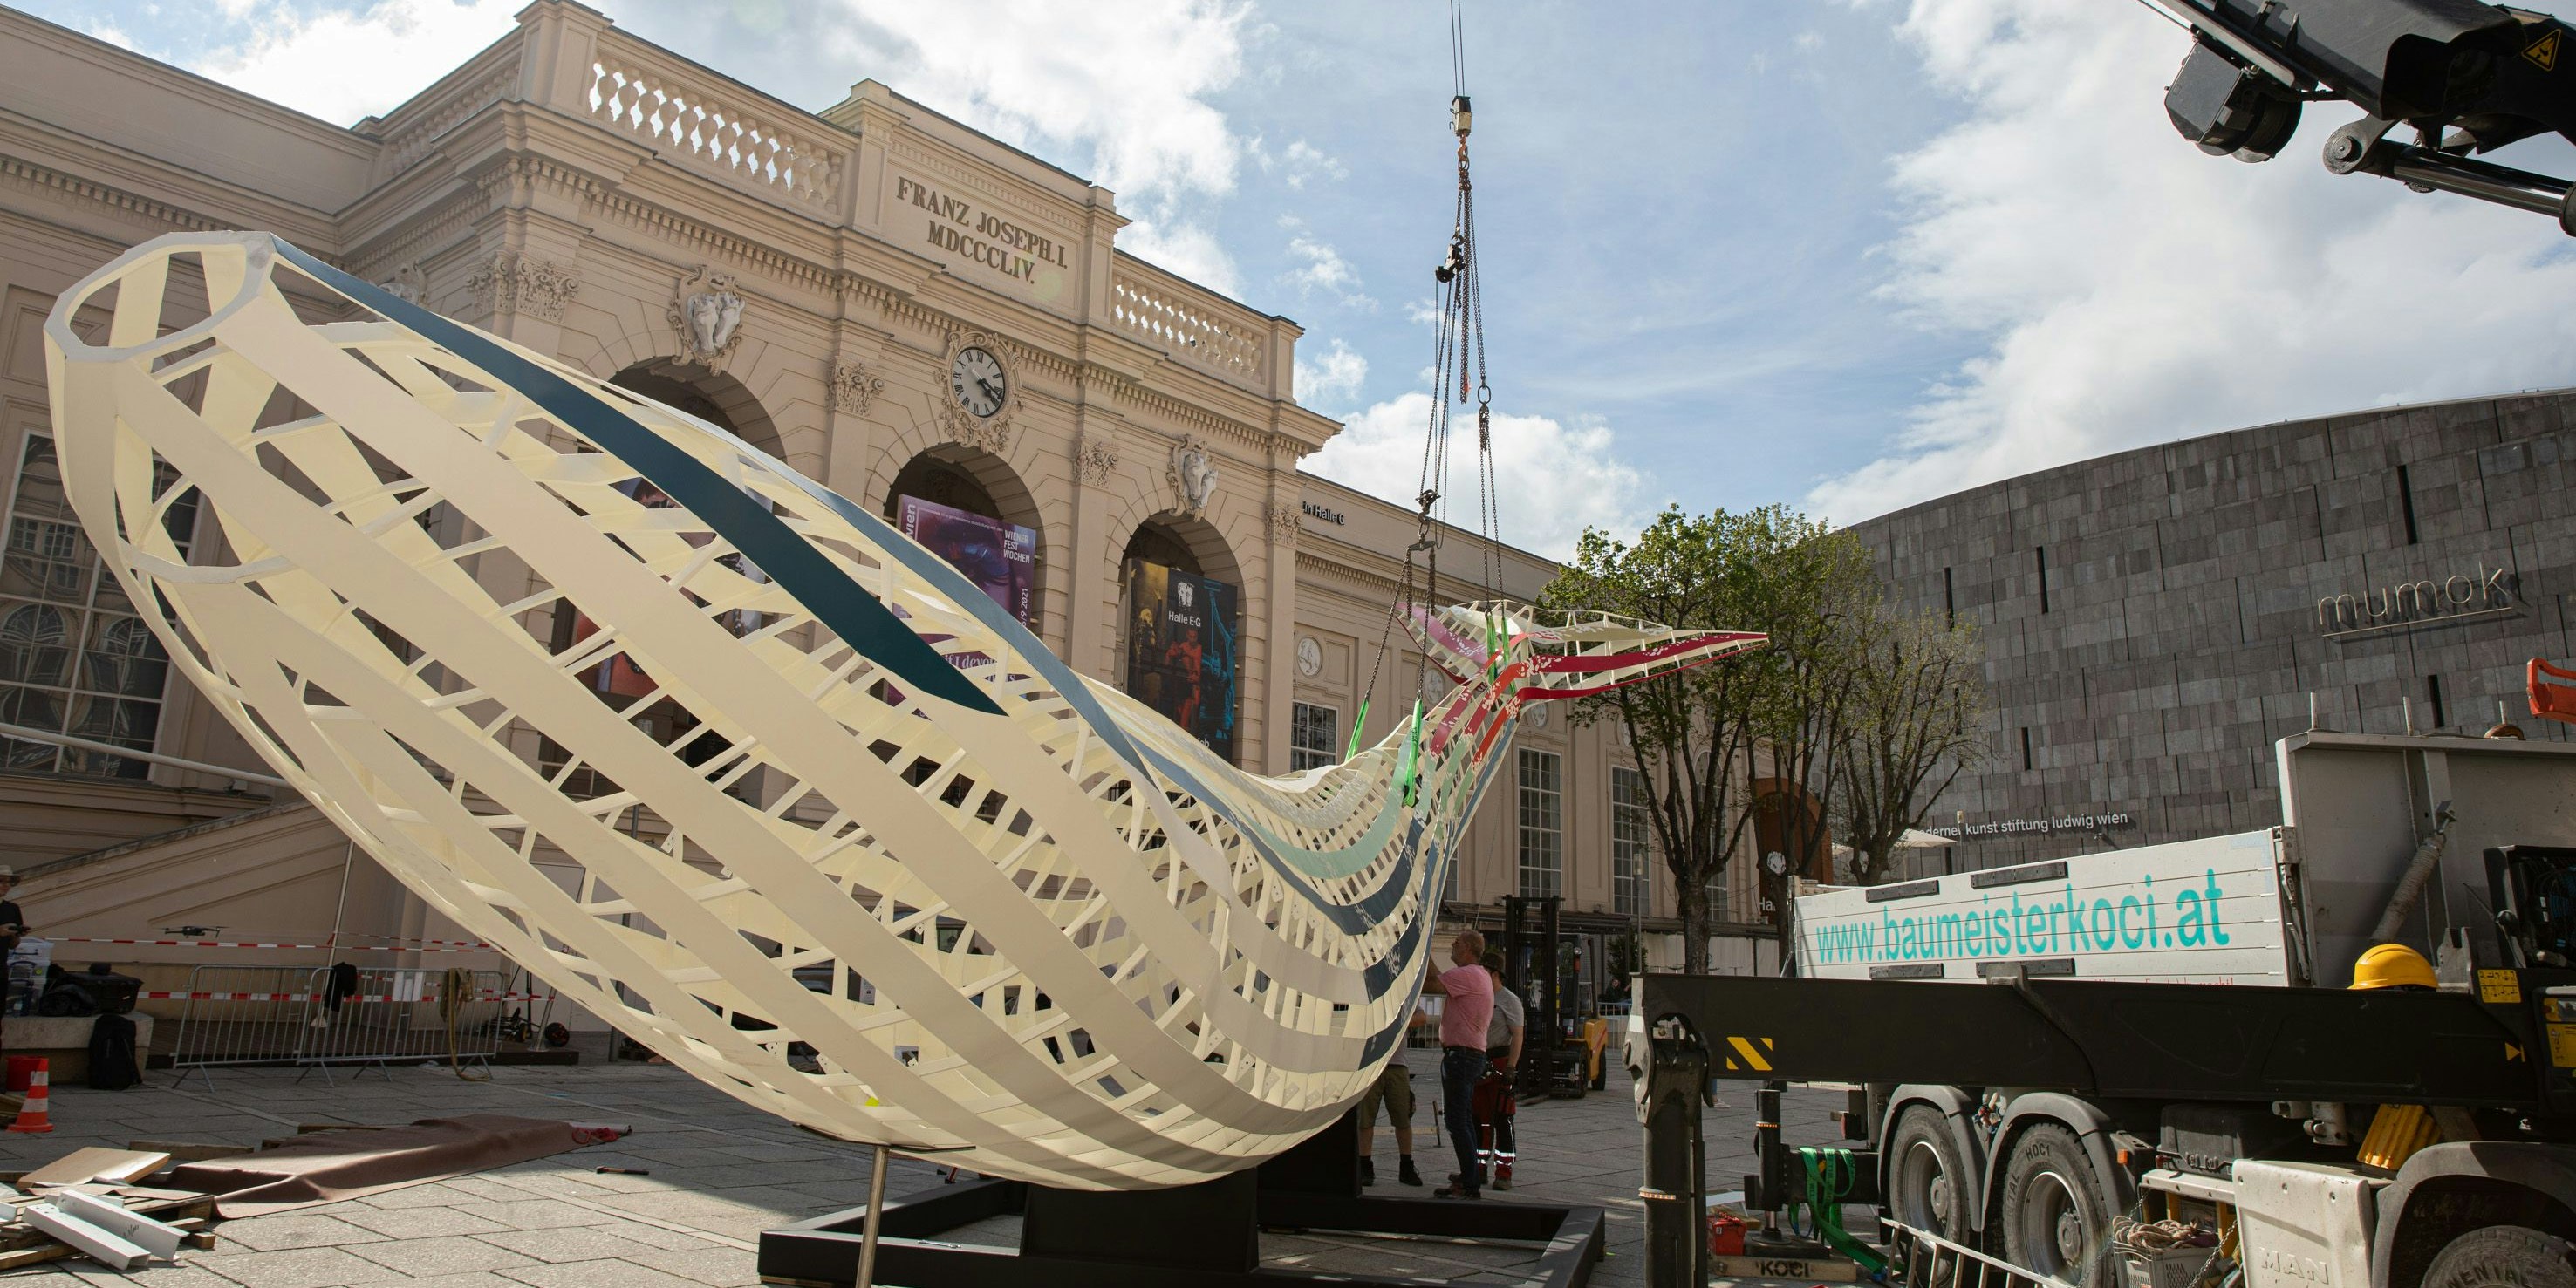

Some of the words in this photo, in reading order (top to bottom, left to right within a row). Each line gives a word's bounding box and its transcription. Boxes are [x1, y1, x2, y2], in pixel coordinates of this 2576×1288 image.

[896, 176, 971, 228] FRANZ
[927, 220, 1035, 284] MDCCCLIV.
[1313, 505, 1338, 522] Halle
[1004, 529, 1029, 545] WIENER
[1004, 539, 1019, 551] FEST
[1003, 549, 1030, 564] WOCHEN
[2317, 560, 2510, 625] mumok
[1168, 610, 1188, 624] Halle
[1965, 822, 1998, 836] kunst
[2001, 818, 2049, 834] stiftung
[2052, 814, 2094, 829] ludwig
[2097, 811, 2128, 825] wien
[1815, 868, 2231, 964] www.baumeisterkoci.at
[2259, 1246, 2330, 1285] MAN
